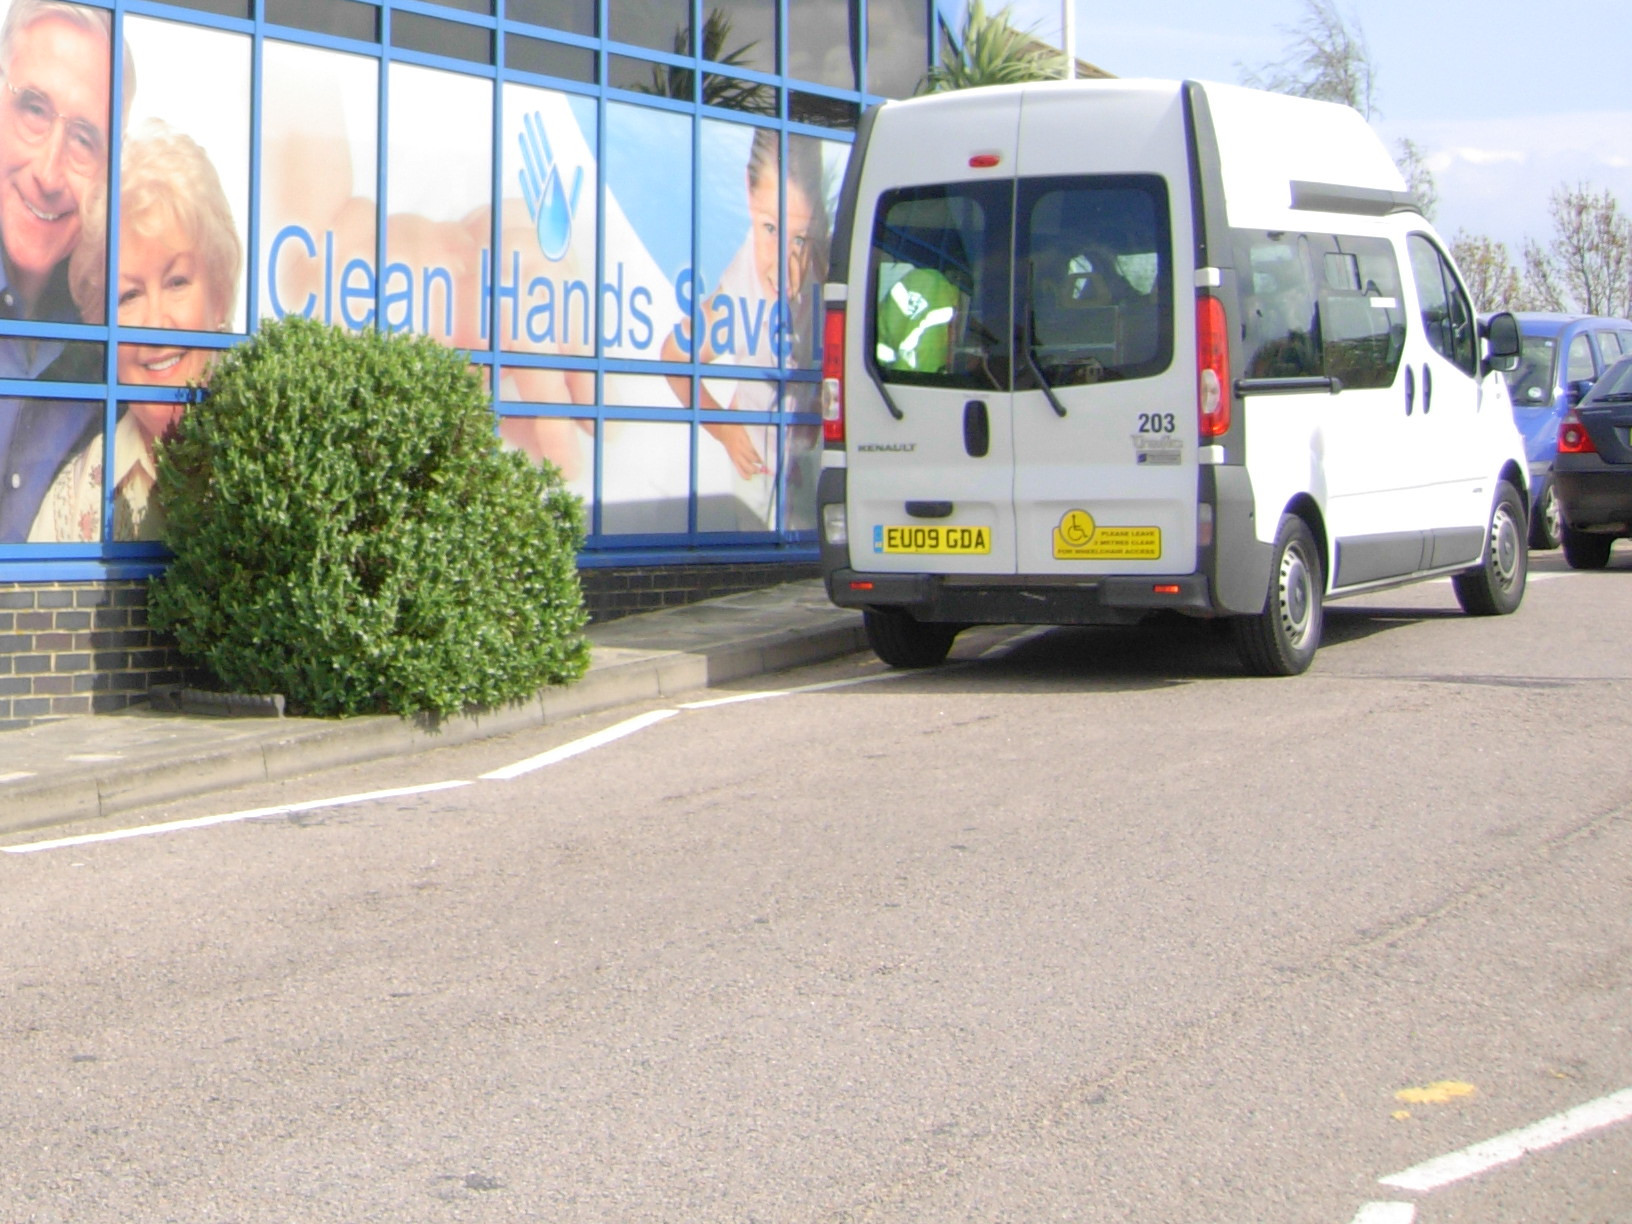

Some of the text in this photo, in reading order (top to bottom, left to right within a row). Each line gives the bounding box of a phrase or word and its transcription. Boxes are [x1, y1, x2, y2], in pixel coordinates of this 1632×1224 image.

[268, 224, 454, 337] Clean
[480, 247, 654, 351] Hands
[673, 267, 793, 359] Save
[1138, 413, 1175, 433] 203
[857, 443, 916, 452] RENAULT
[887, 529, 985, 549] EU09 GDA
